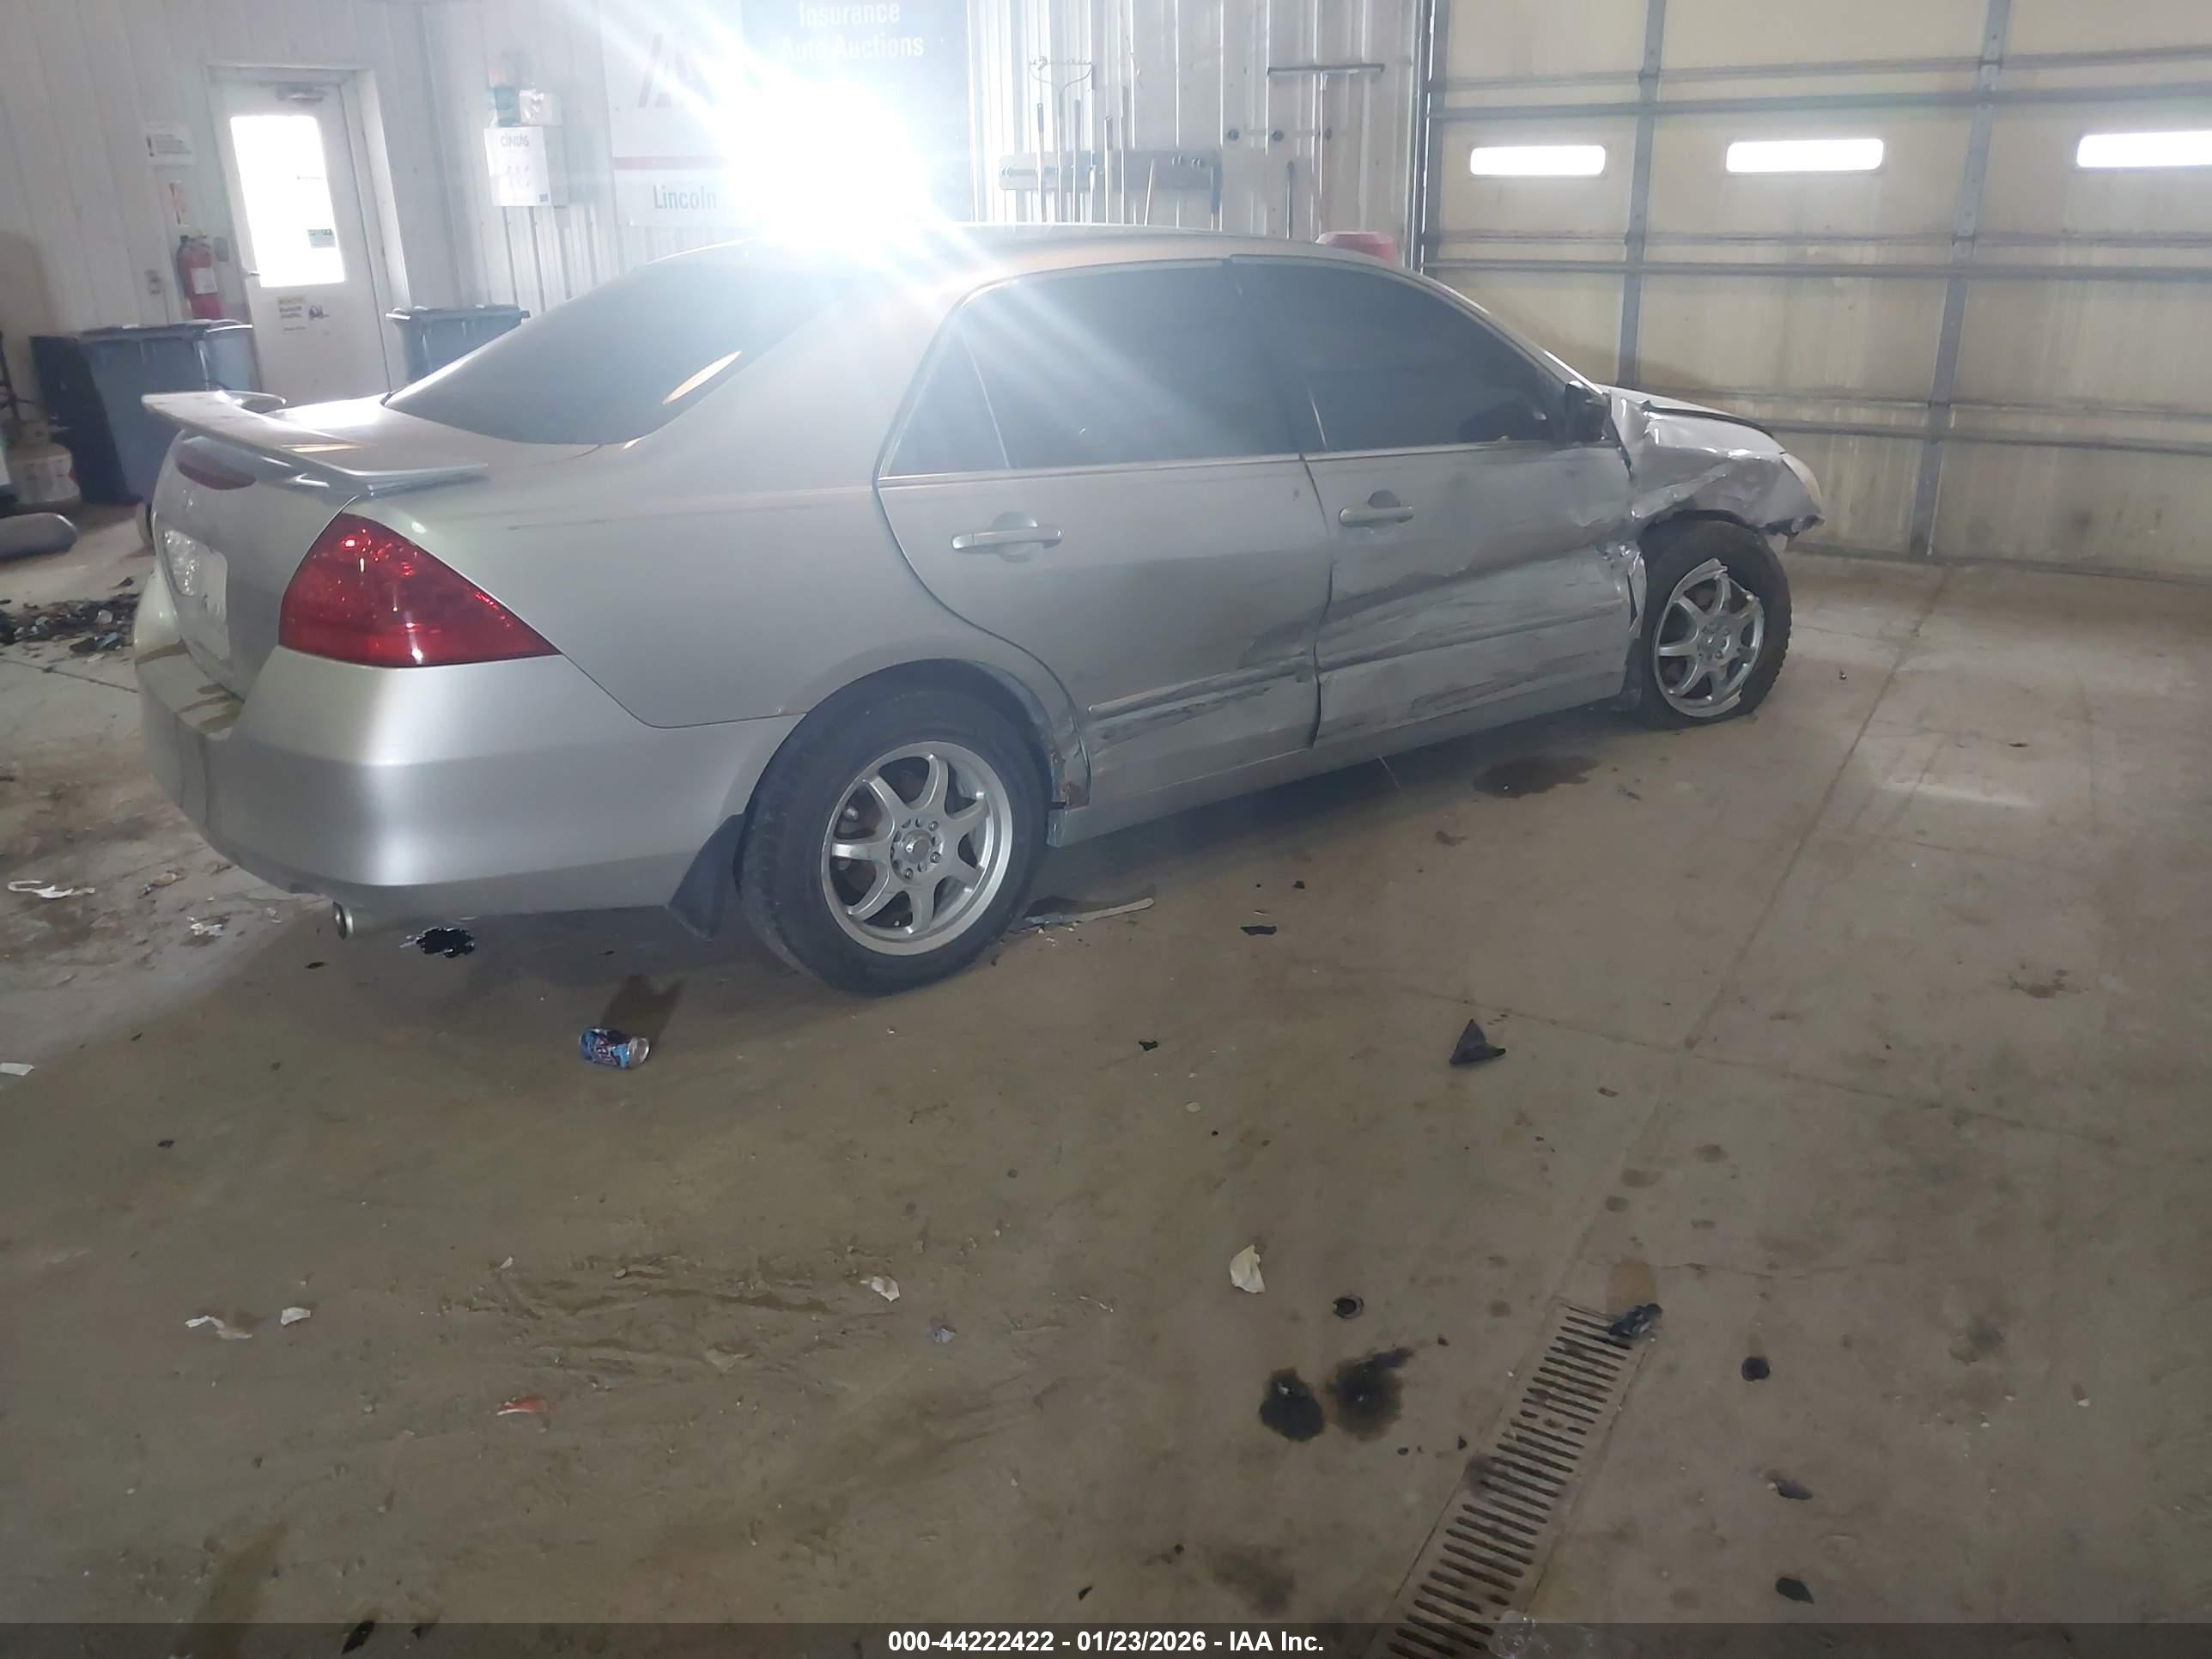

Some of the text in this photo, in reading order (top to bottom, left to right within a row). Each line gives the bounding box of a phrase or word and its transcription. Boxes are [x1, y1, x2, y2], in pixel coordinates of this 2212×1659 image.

[799, 0, 901, 29] Insurance
[781, 32, 925, 62] Auto Auctions
[653, 185, 718, 210] Lincoln
